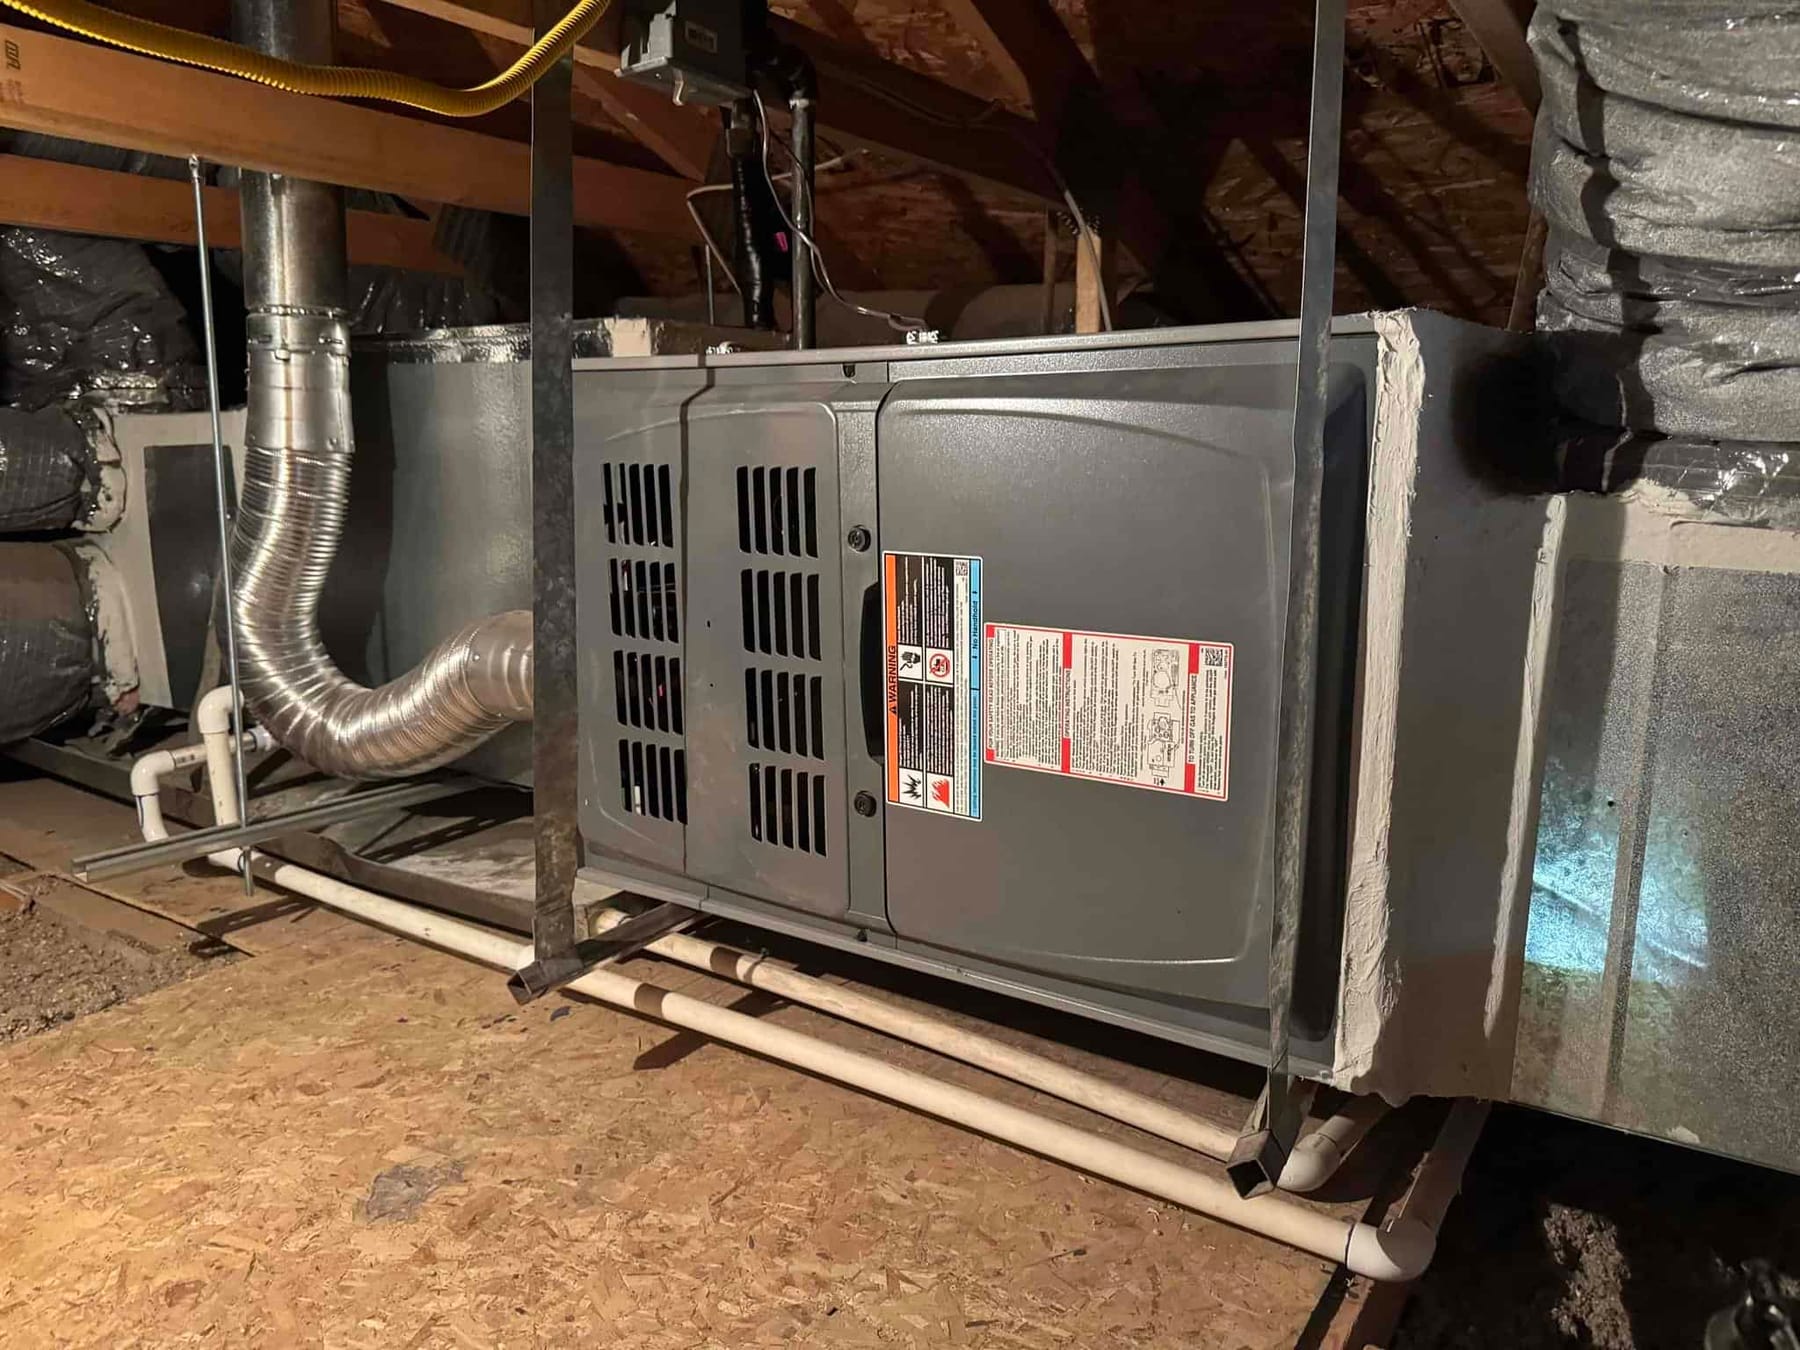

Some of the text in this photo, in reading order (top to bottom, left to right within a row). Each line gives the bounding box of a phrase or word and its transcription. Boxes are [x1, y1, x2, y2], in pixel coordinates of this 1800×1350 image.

[972, 639, 978, 650] No
[888, 645, 898, 704] WARNING
[1190, 706, 1196, 714] TO
[1188, 755, 1194, 763] TO
